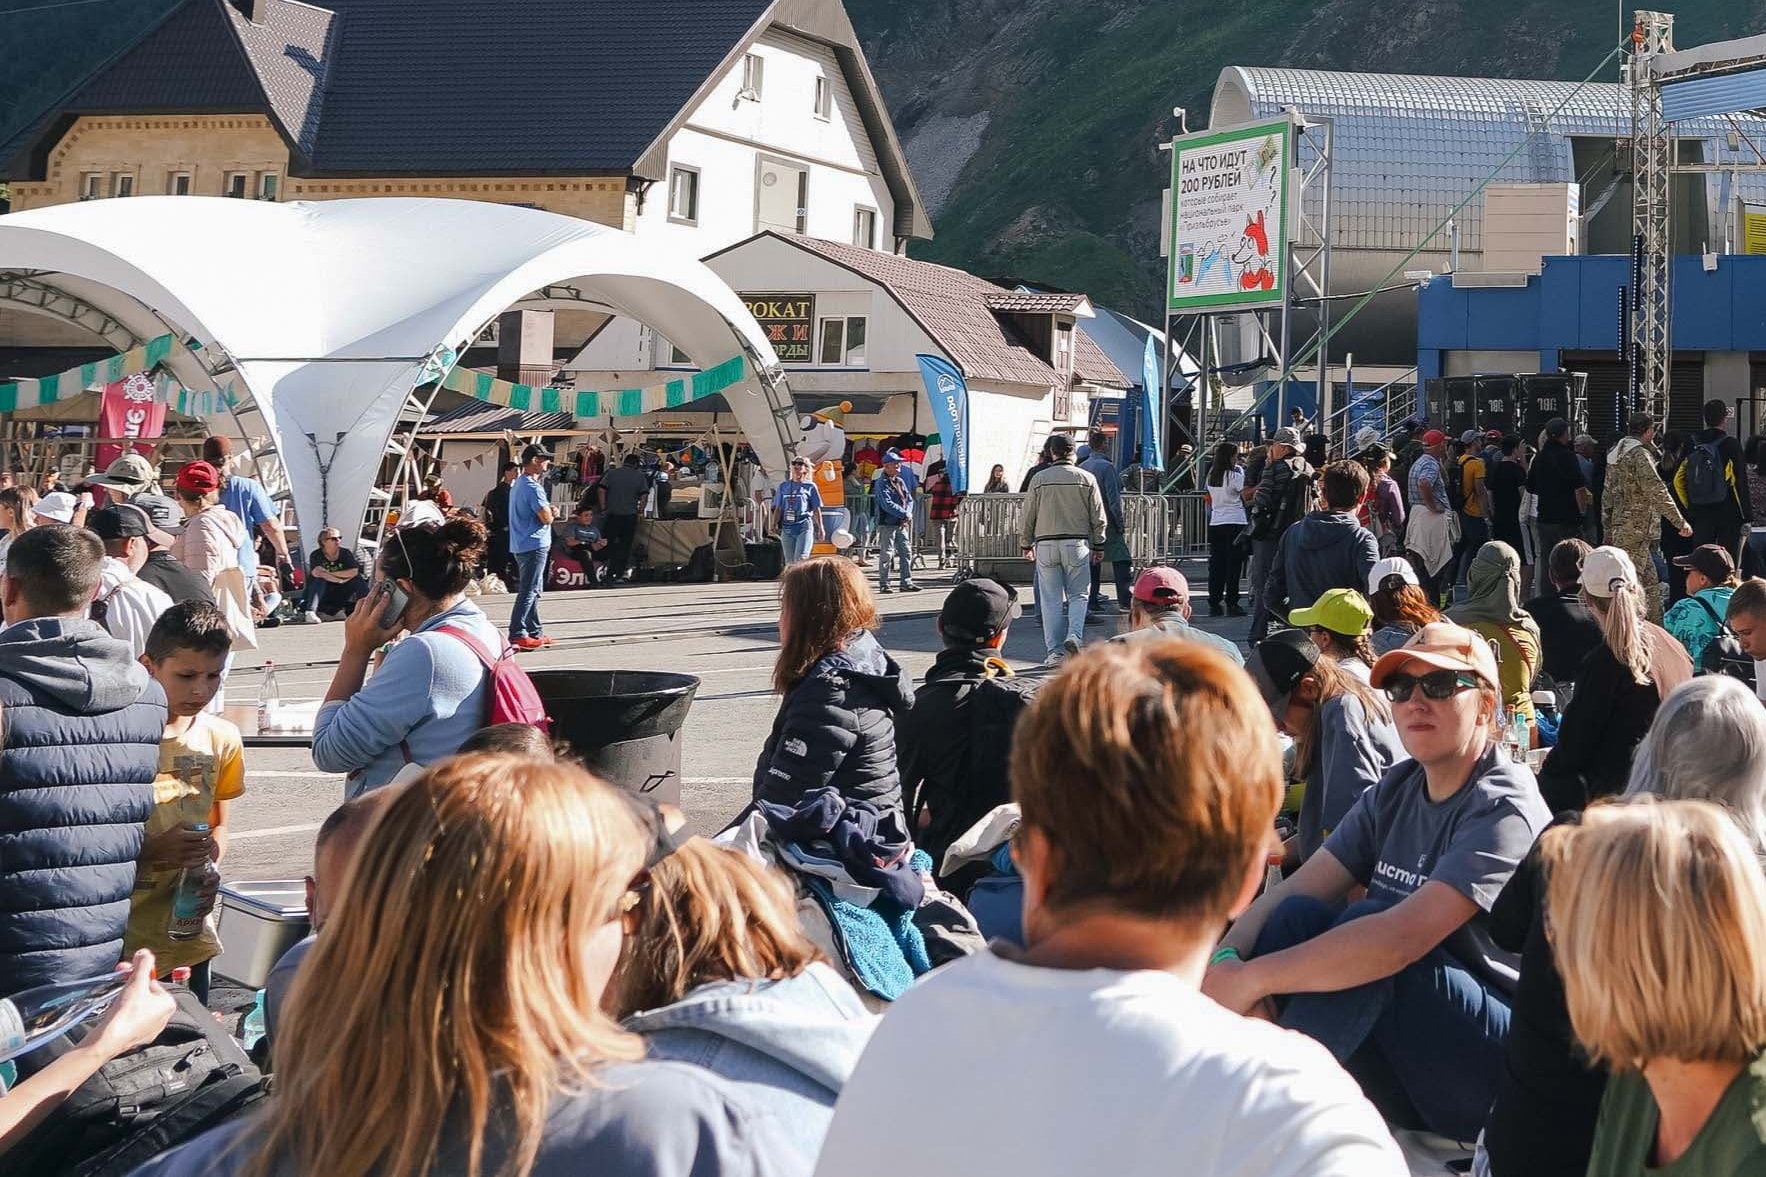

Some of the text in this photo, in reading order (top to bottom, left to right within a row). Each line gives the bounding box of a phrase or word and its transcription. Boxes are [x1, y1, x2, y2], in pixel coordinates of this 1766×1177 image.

[1182, 150, 1248, 174] НА ЧТО ИДУТ
[1181, 168, 1241, 194] 200 РУБЛЕЙ
[745, 301, 810, 318] РОКАТ
